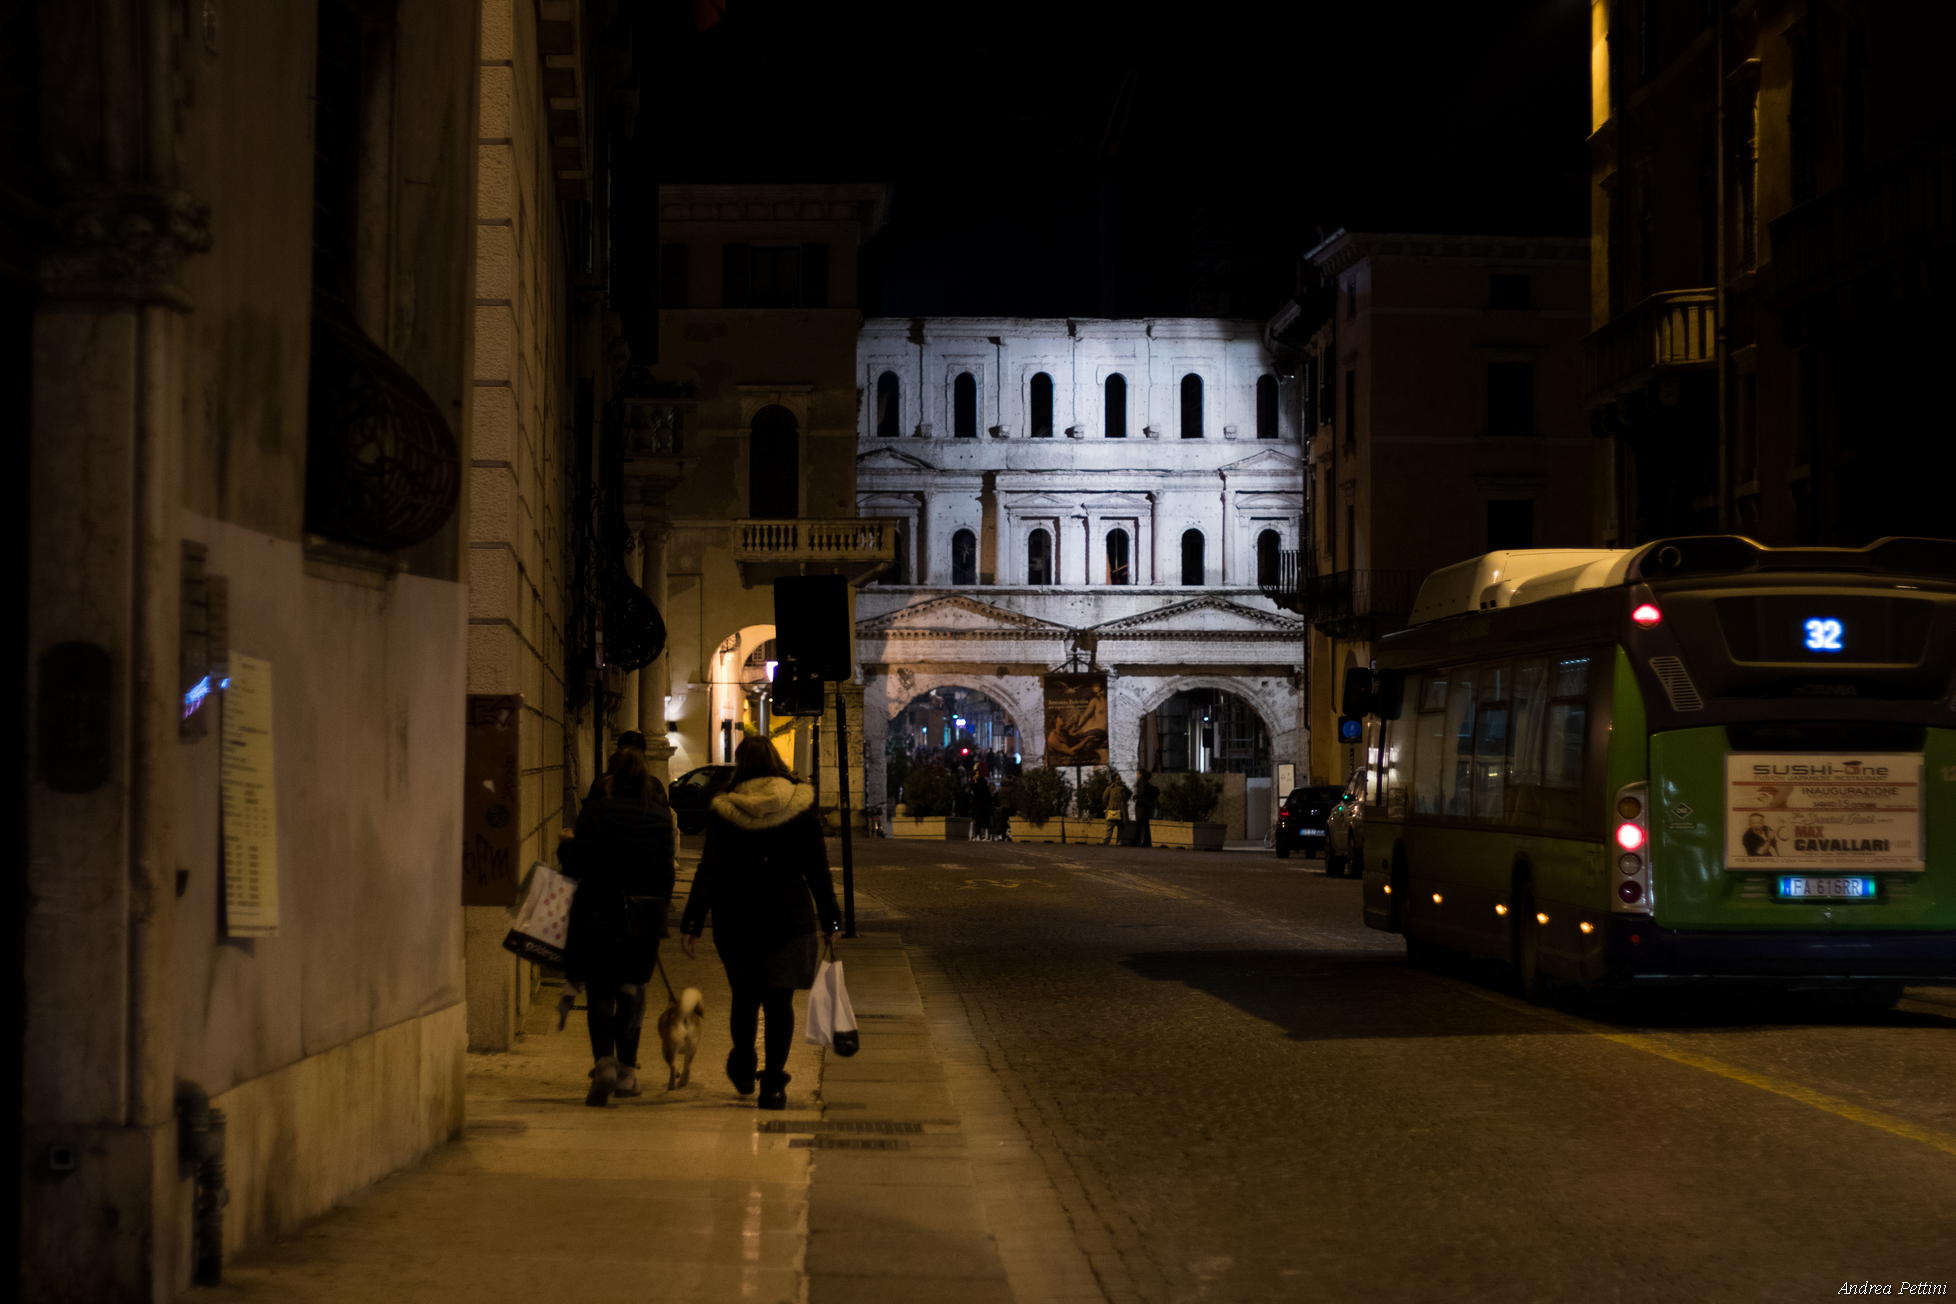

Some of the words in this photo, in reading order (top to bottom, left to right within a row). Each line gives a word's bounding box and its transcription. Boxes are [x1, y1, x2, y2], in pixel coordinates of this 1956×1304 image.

[1803, 617, 1844, 651] 32
[1801, 786, 1899, 796] INAUGURAZIONE
[1794, 825, 1825, 838] MAX
[1794, 839, 1890, 852] CAVALLARI
[1793, 880, 1811, 894] FA
